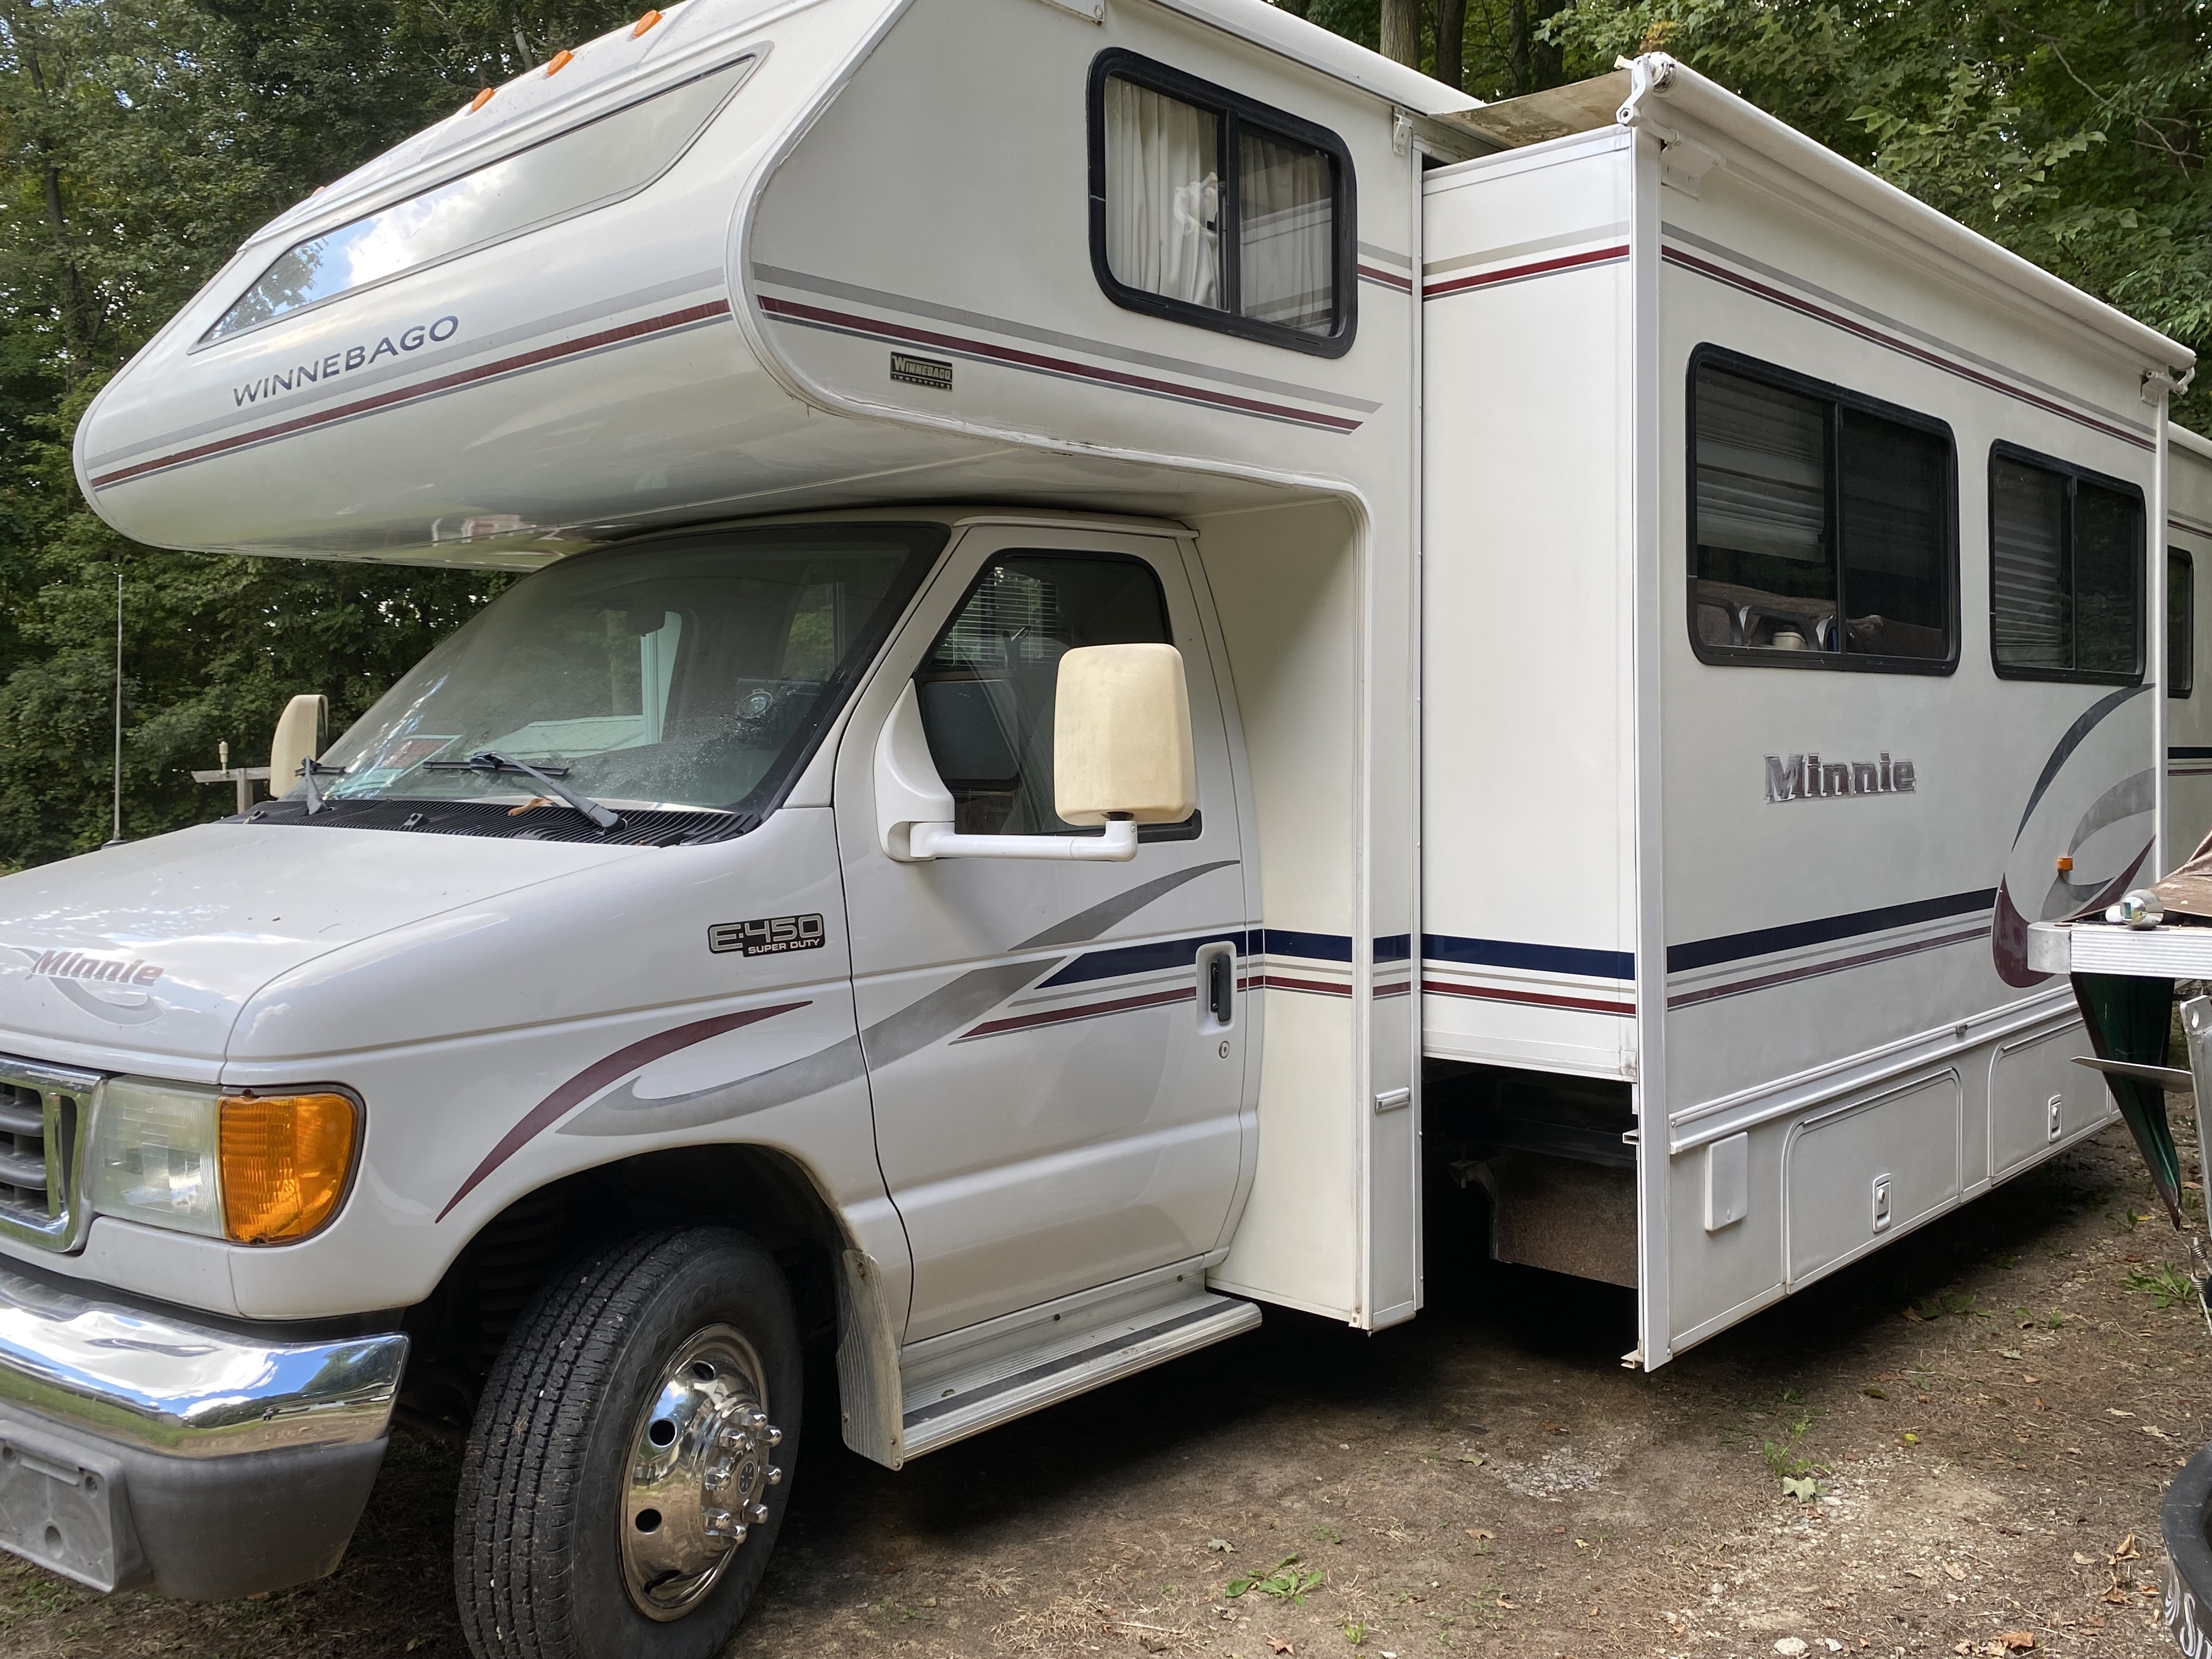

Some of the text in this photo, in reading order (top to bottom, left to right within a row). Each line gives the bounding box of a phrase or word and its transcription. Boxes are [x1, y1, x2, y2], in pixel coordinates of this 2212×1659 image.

[233, 315, 459, 407] WINNEBAGO
[891, 355, 951, 380] WINNEBAGO
[1763, 750, 1917, 804] Minnie
[748, 938, 820, 954] SUPER DUTY
[30, 950, 165, 986] Minnie
